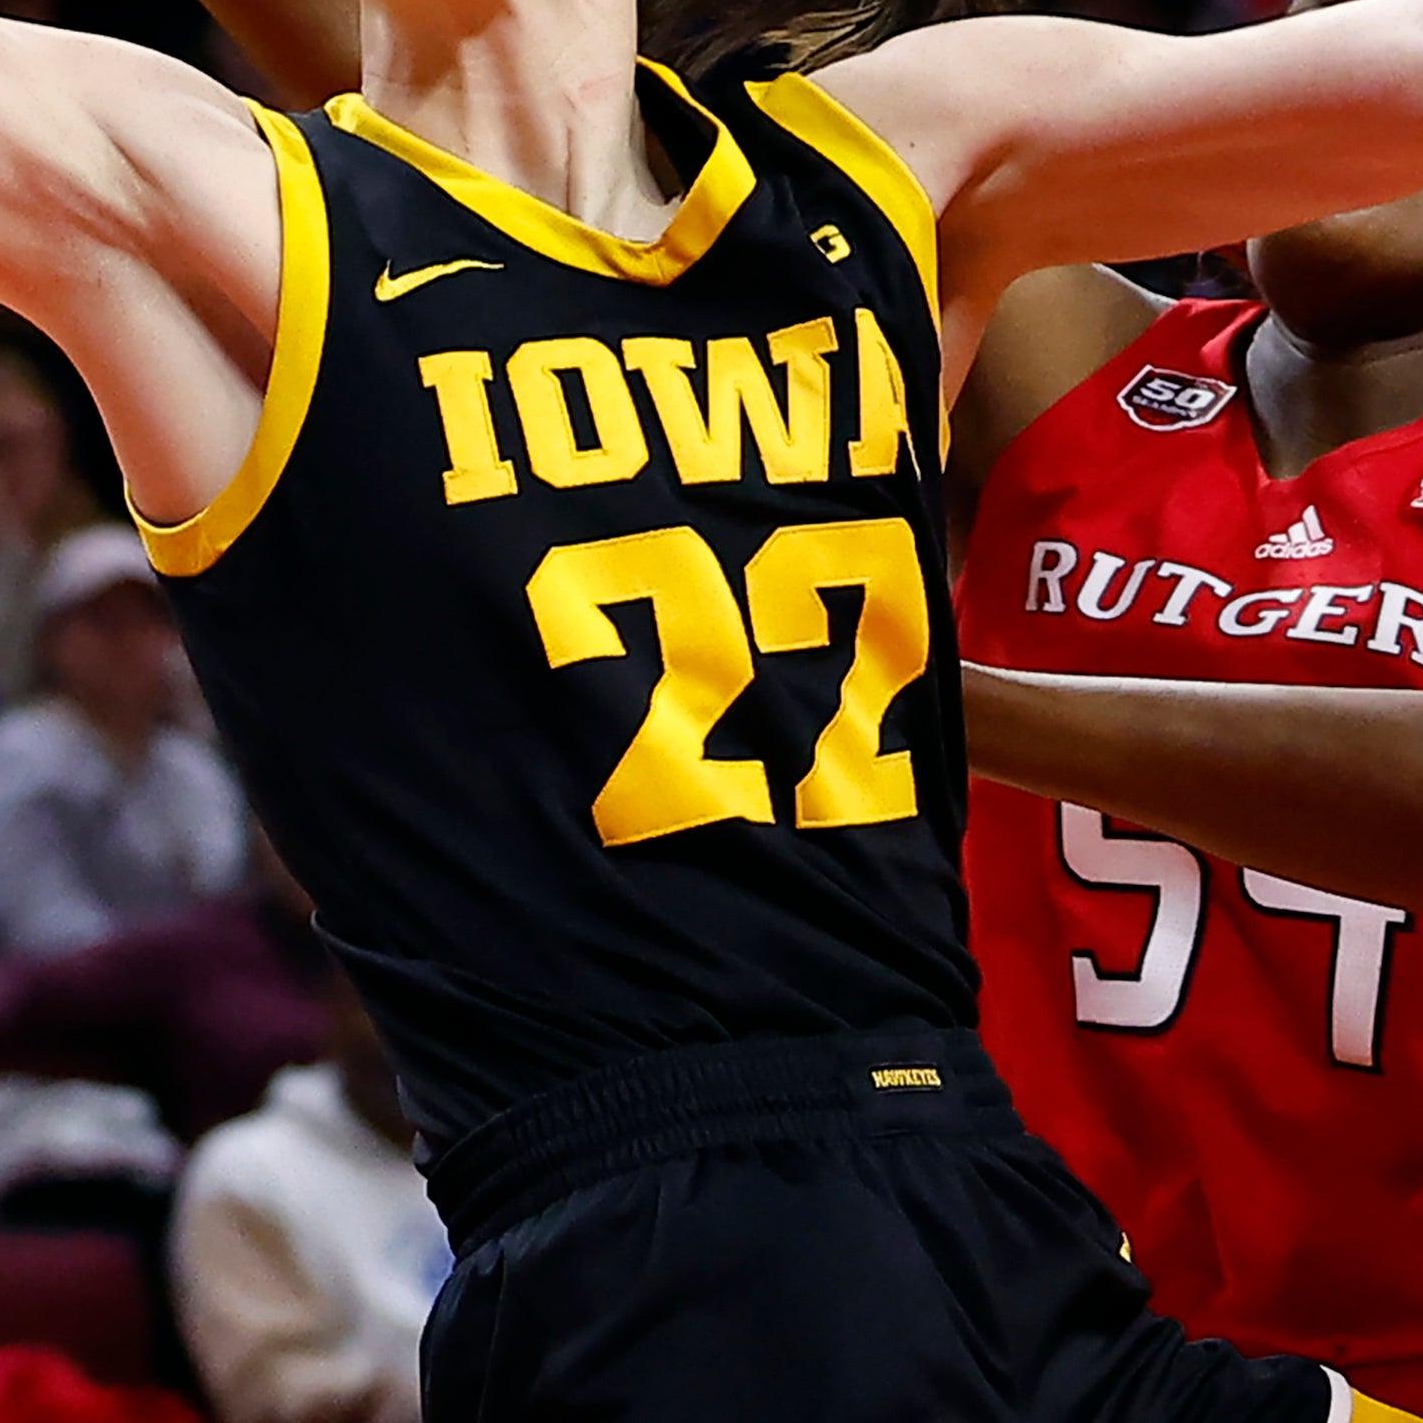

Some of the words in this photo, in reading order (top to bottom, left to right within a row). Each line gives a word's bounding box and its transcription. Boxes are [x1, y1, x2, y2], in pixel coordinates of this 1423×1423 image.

[418, 307, 922, 506] IOWA
[1140, 378, 1216, 409] 50
[1254, 537, 1334, 559] adidas
[526, 517, 930, 847] 22
